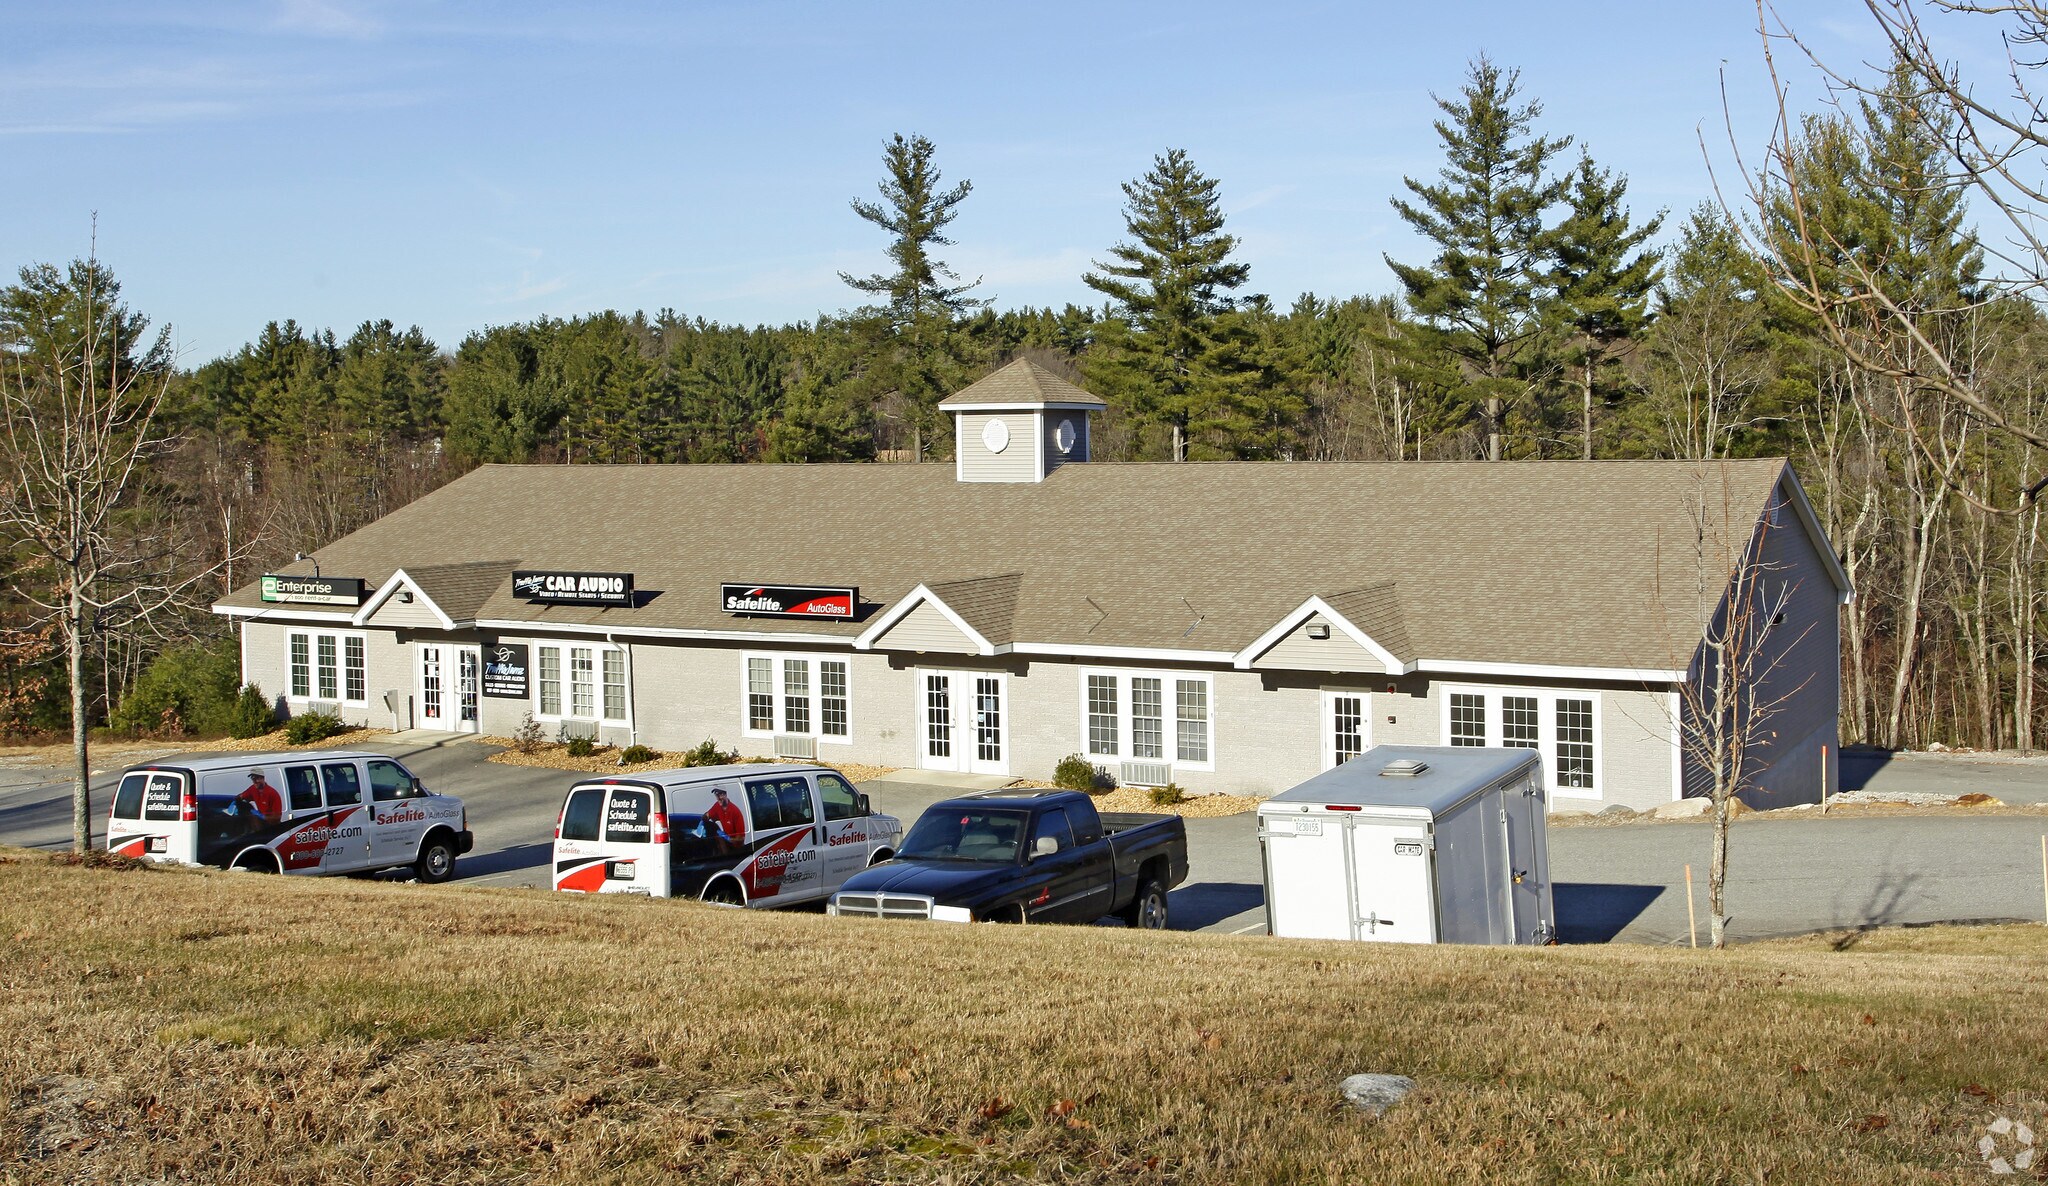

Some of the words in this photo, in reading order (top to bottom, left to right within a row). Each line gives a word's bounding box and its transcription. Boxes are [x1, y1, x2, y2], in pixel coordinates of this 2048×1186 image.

[276, 580, 332, 595] Enterprise
[546, 576, 576, 591] CAR
[578, 577, 624, 593] AUDIO
[726, 596, 781, 611] Safelite
[807, 603, 846, 614] AutoGlass
[150, 782, 165, 791] Quote
[166, 782, 171, 791] &
[149, 792, 170, 800] Schedule
[147, 802, 180, 811] safelite.com
[611, 799, 630, 808] Quote
[631, 799, 637, 809] &
[376, 810, 425, 825] Safelite
[428, 809, 460, 820] AutoGlass
[609, 810, 637, 820] Schedule
[608, 822, 649, 832] safelite.com
[295, 826, 362, 844] safelite.com
[829, 832, 866, 846] Safelite
[758, 849, 816, 869] safelite.com
